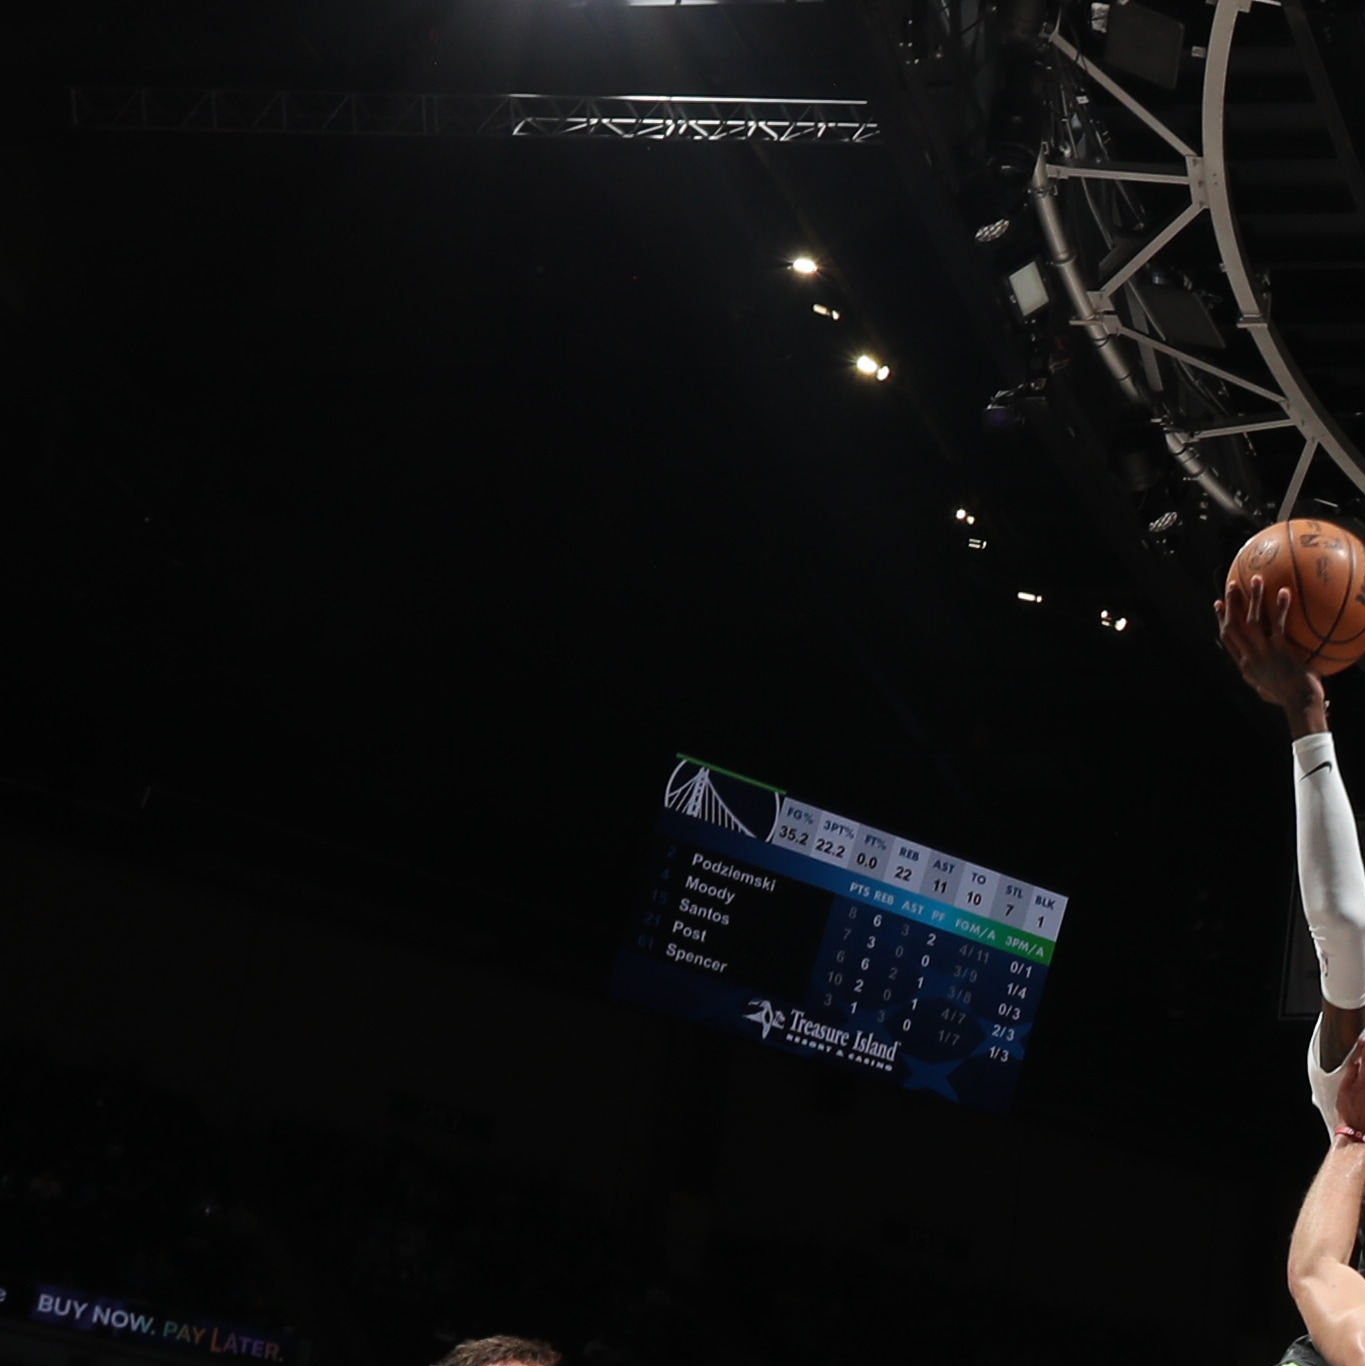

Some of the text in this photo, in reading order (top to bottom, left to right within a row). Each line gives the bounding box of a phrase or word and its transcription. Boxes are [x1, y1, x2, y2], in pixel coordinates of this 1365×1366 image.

[692, 853, 777, 892] Podziemski
[779, 826, 809, 845] 35.2
[815, 838, 845, 858] 22.2
[856, 853, 877, 869] 0.0
[894, 866, 912, 882] 22
[933, 880, 947, 894] 11
[967, 891, 981, 905] 10
[1005, 904, 1014, 917] 7
[787, 807, 1055, 910] FG% 3PT% FT% REB AST TO STL BLK
[678, 898, 730, 926] Santos
[685, 875, 736, 905] Moody
[672, 920, 707, 943] Post
[850, 881, 1044, 958] PTS REB AST PF FGM/A 3PM/A
[665, 943, 728, 973] Spencer
[789, 1008, 900, 1061] Treasure Island
[37, 1293, 88, 1320] BUY
[92, 1305, 156, 1336] NOW.
[162, 1320, 206, 1345] PAY
[209, 1328, 284, 1362] LATER.
